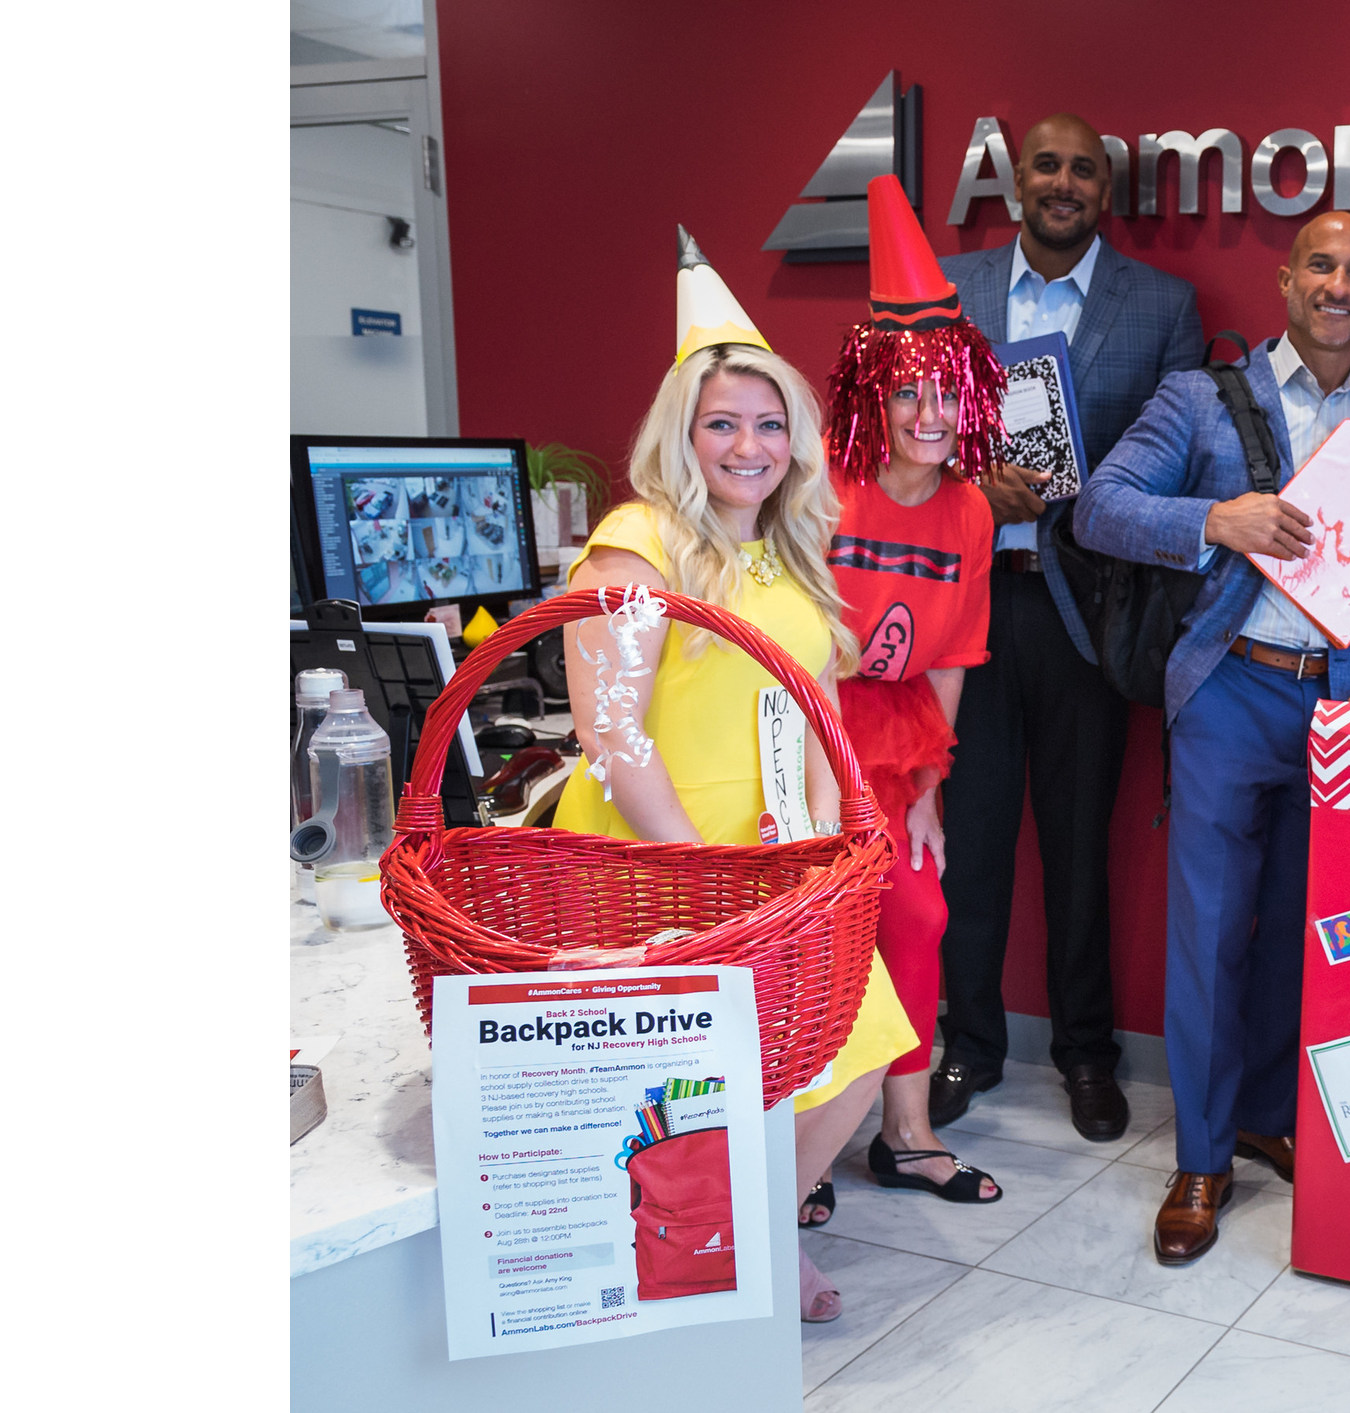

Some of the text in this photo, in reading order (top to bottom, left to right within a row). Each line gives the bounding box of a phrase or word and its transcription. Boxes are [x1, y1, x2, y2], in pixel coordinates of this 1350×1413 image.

[764, 689, 789, 717] NO.
[528, 983, 661, 996] #AmmonCares Giving Opportunity
[546, 1010, 567, 1018] Back
[578, 1008, 607, 1017] School
[480, 1009, 712, 1045] Backpack Drive
[572, 1033, 707, 1051] for NJ Recovery High Schools
[489, 1072, 510, 1080] honor
[522, 1069, 558, 1078] Recovery
[590, 1064, 645, 1074] #TeamAmmon
[655, 1060, 691, 1071] organizing
[480, 1082, 505, 1091] school
[507, 1081, 531, 1090] supply
[534, 1079, 569, 1088] collection
[571, 1077, 589, 1085] drive
[600, 1075, 628, 1084] support
[488, 1092, 525, 1101] NJ-based
[527, 1090, 558, 1100] recovery
[560, 1088, 577, 1097] high
[482, 1103, 507, 1112] Please
[509, 1102, 522, 1112] join
[535, 1101, 544, 1109] by
[546, 1098, 589, 1108] contributing
[592, 1095, 616, 1104] school
[482, 1114, 514, 1124] supplies
[526, 1110, 552, 1121] making
[561, 1107, 591, 1116] financial
[593, 1104, 627, 1113] donation.
[484, 1128, 519, 1140] Together
[550, 1124, 572, 1132] make
[580, 1120, 622, 1130] difference!
[479, 1153, 499, 1161] How
[513, 1148, 563, 1159] Participate:
[492, 1165, 600, 1181] Purchase designated supplies
[493, 1183, 512, 1191] (refer
[523, 1179, 556, 1189] shopping
[580, 1174, 602, 1182] items)
[495, 1203, 512, 1211] Drop
[525, 1198, 555, 1208] supplies
[571, 1193, 602, 1203] donation
[495, 1211, 528, 1219] Deadline:
[548, 1206, 568, 1214] 22nd
[496, 1229, 511, 1237] Join
[532, 1224, 567, 1233] assemble
[568, 1220, 608, 1230] backpacks
[514, 1237, 530, 1245] 28th
[541, 1233, 572, 1241] 12:00PM
[497, 1251, 573, 1265] Financial donations
[512, 1264, 547, 1272] welcome
[499, 1280, 531, 1289] Questions?
[528, 1306, 555, 1314] shopping
[533, 1312, 567, 1321] contribution
[501, 1311, 637, 1336] AmmonLabs.com/BackpackDrive
